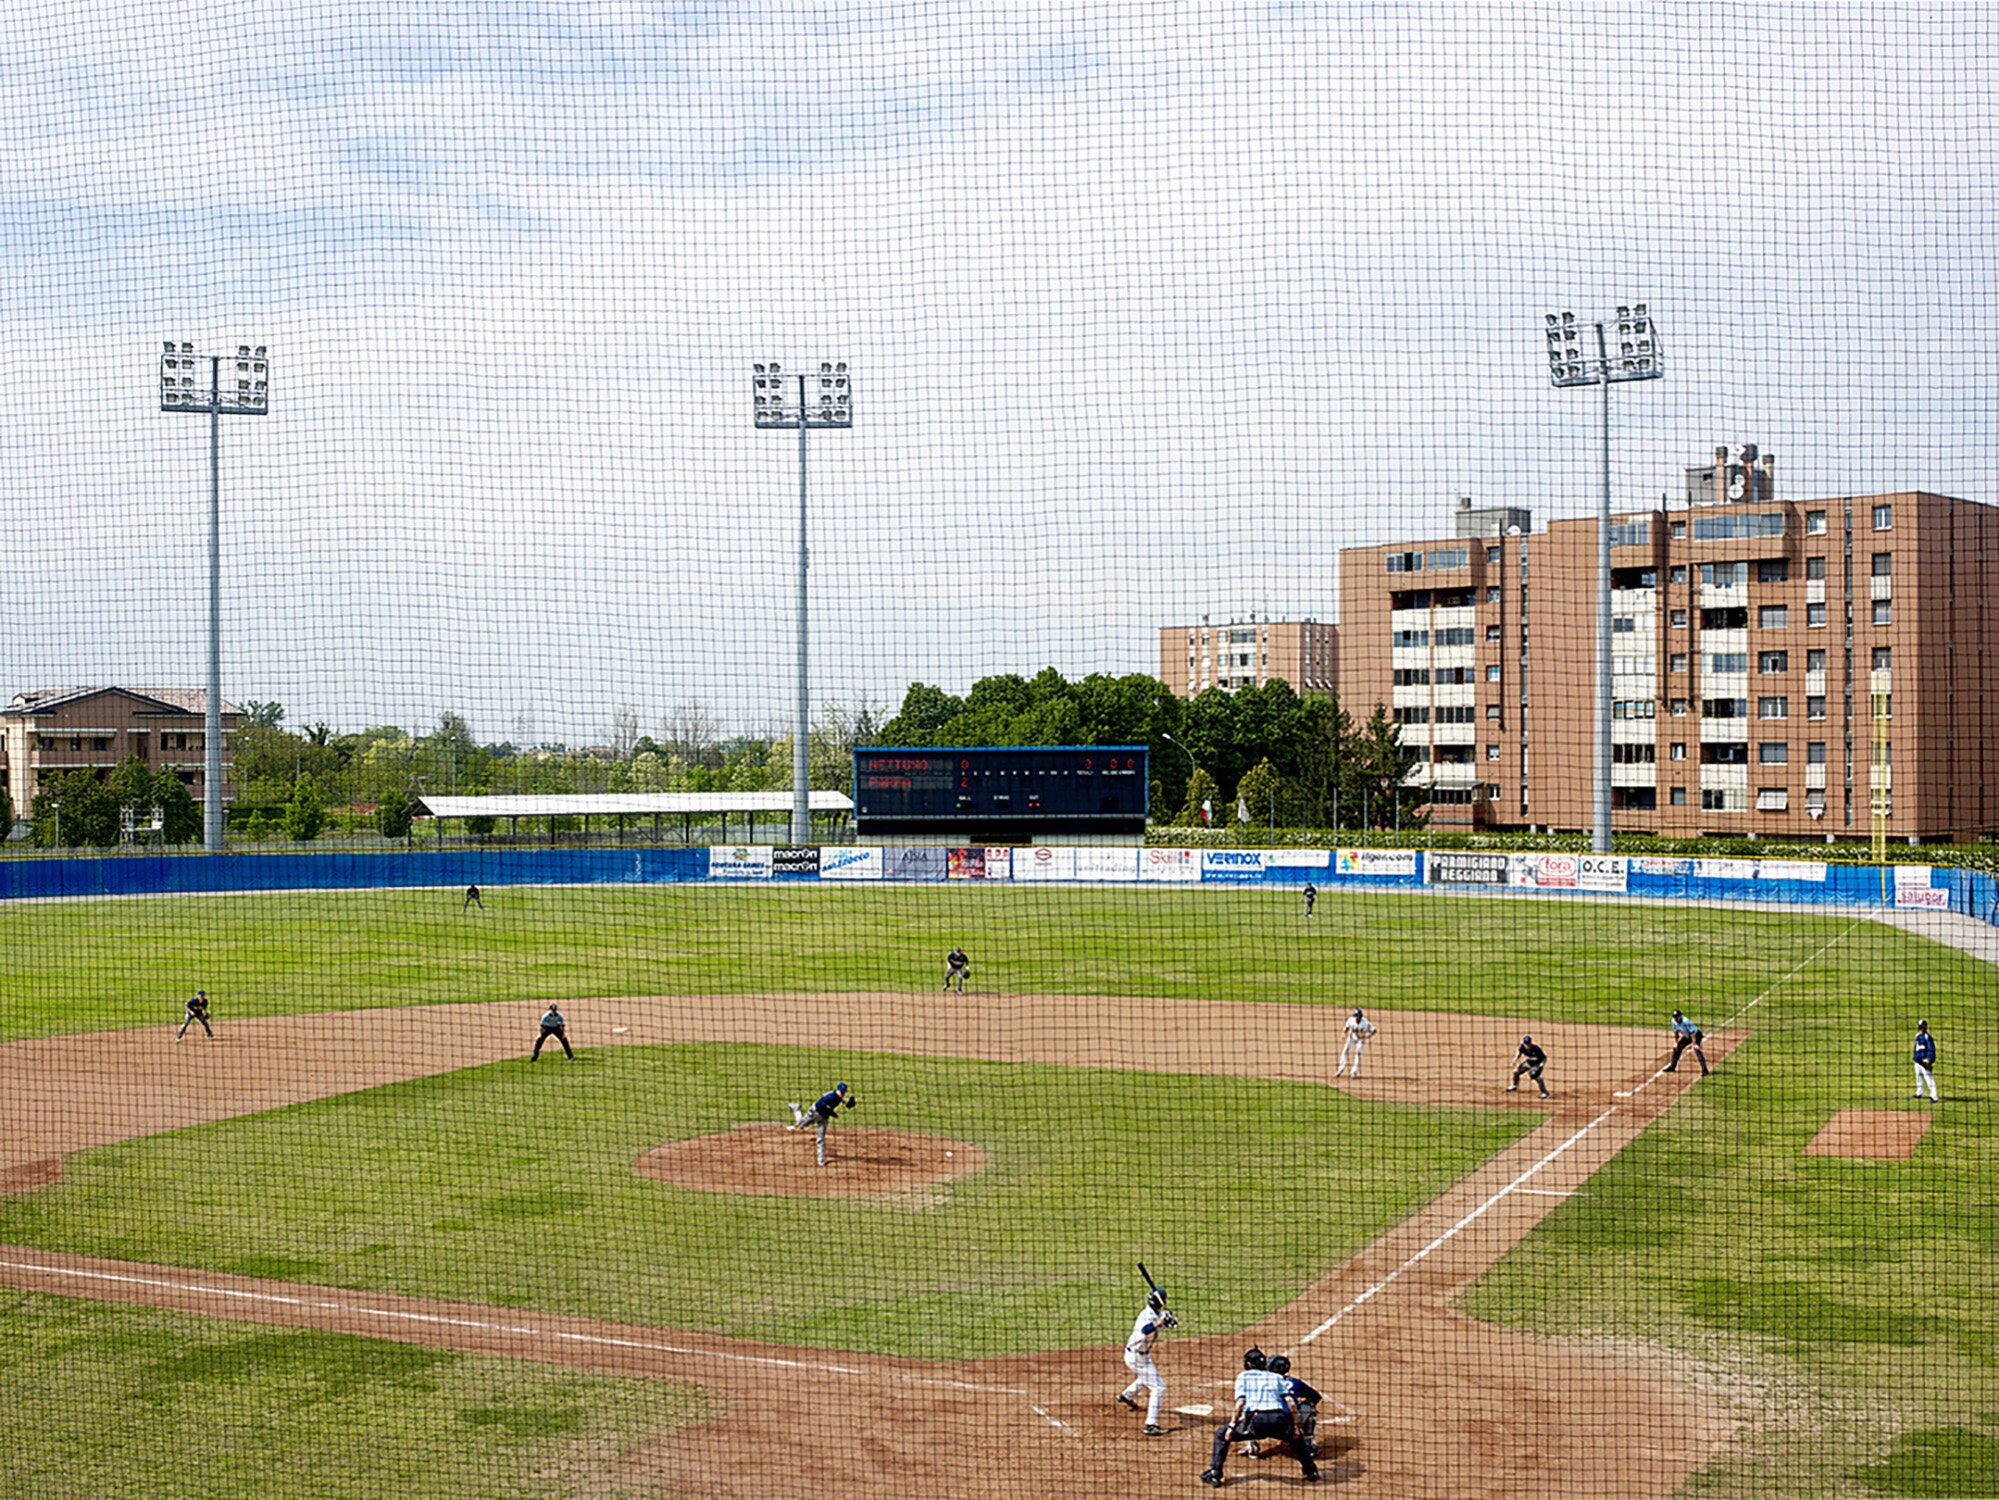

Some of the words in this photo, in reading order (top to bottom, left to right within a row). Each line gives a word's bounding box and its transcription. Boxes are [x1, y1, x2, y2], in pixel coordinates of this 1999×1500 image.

[868, 759, 928, 770] NETTUNO
[960, 759, 969, 770] 0
[1110, 758, 1117, 769] 0
[1127, 758, 1134, 769] 0
[960, 777, 969, 788] 2
[774, 848, 818, 859] macron
[1206, 852, 1261, 865] VERINOX
[774, 860, 818, 871] macron
[1433, 855, 1506, 870] PARMIGIANO
[1582, 860, 1625, 874] O.C.E.
[1440, 868, 1498, 882] REGGIANO
